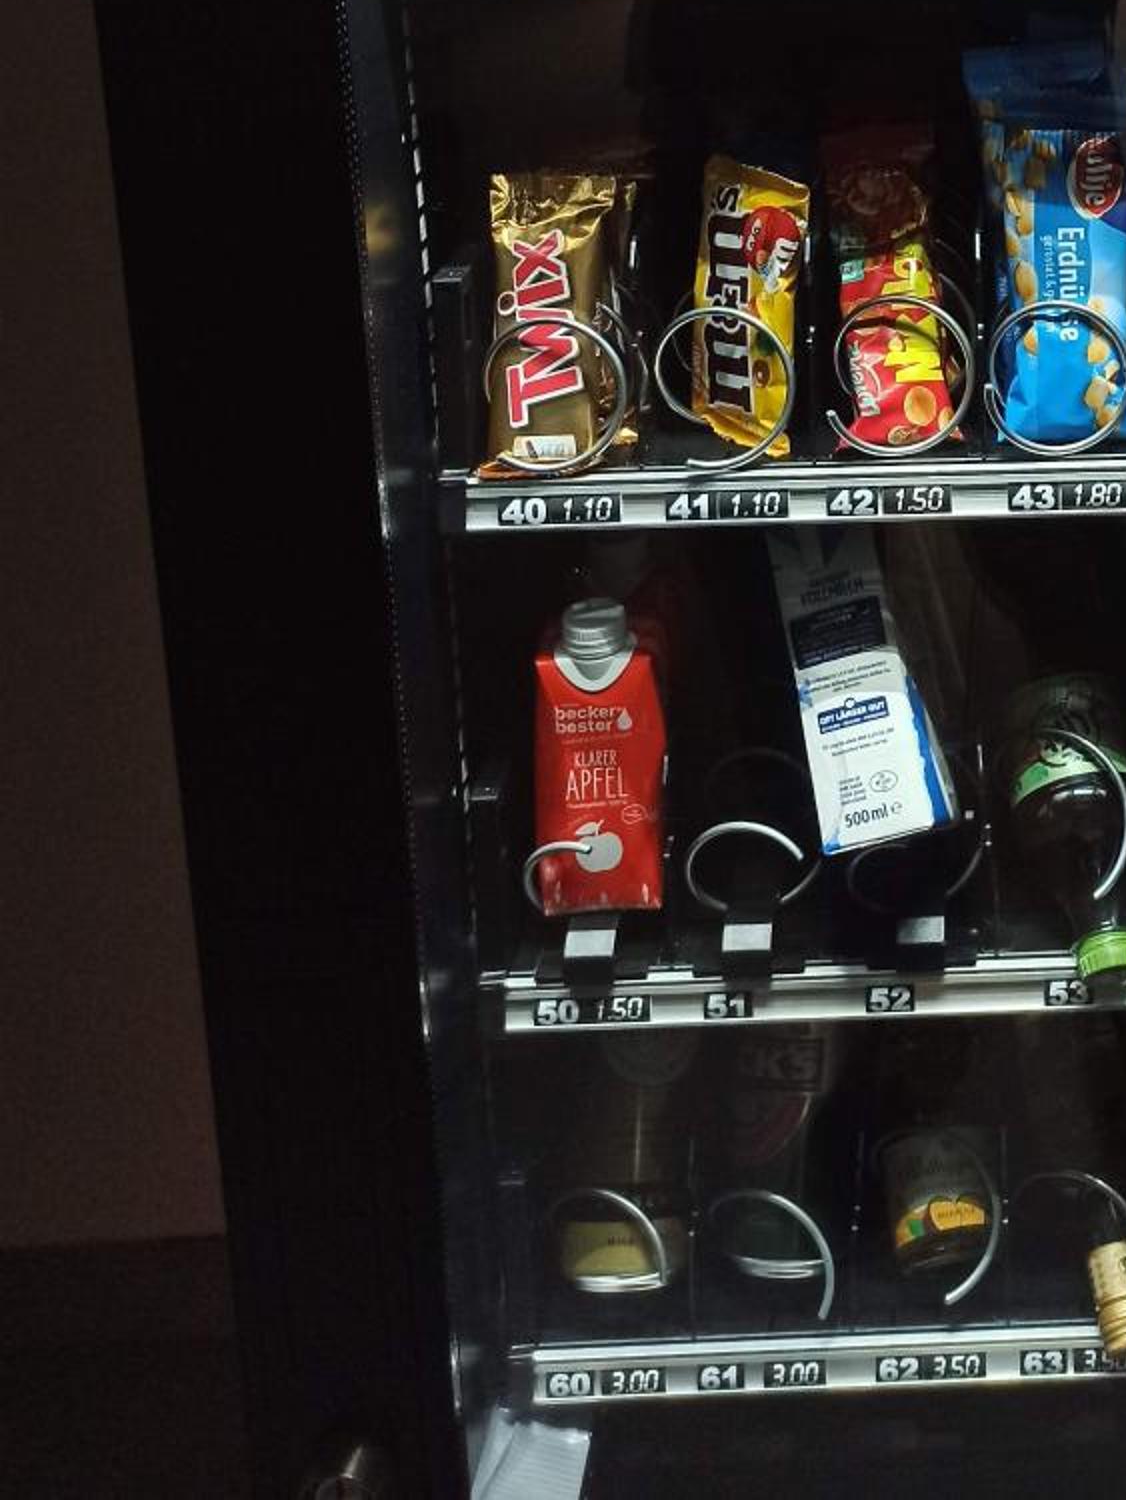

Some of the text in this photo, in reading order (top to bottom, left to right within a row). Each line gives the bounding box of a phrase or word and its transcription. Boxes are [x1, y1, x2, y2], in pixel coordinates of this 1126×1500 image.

[1057, 226, 1087, 343] Erdnüse
[669, 492, 781, 520] 41 1.10
[830, 487, 945, 516] 42 1.50
[1011, 482, 1122, 510] 43 1.80
[501, 496, 613, 525] 40 1.10
[574, 748, 618, 768] KLARER
[565, 767, 629, 801] APFEL
[706, 993, 747, 1019] 51
[870, 986, 912, 1012] 52
[1048, 980, 1089, 1006] 53
[538, 1000, 579, 1026] 50
[700, 1361, 820, 1390] 61 3.00
[880, 1354, 980, 1382] 62 3.50
[1024, 1352, 1065, 1376] 63
[549, 1369, 659, 1397] 60 3.00
